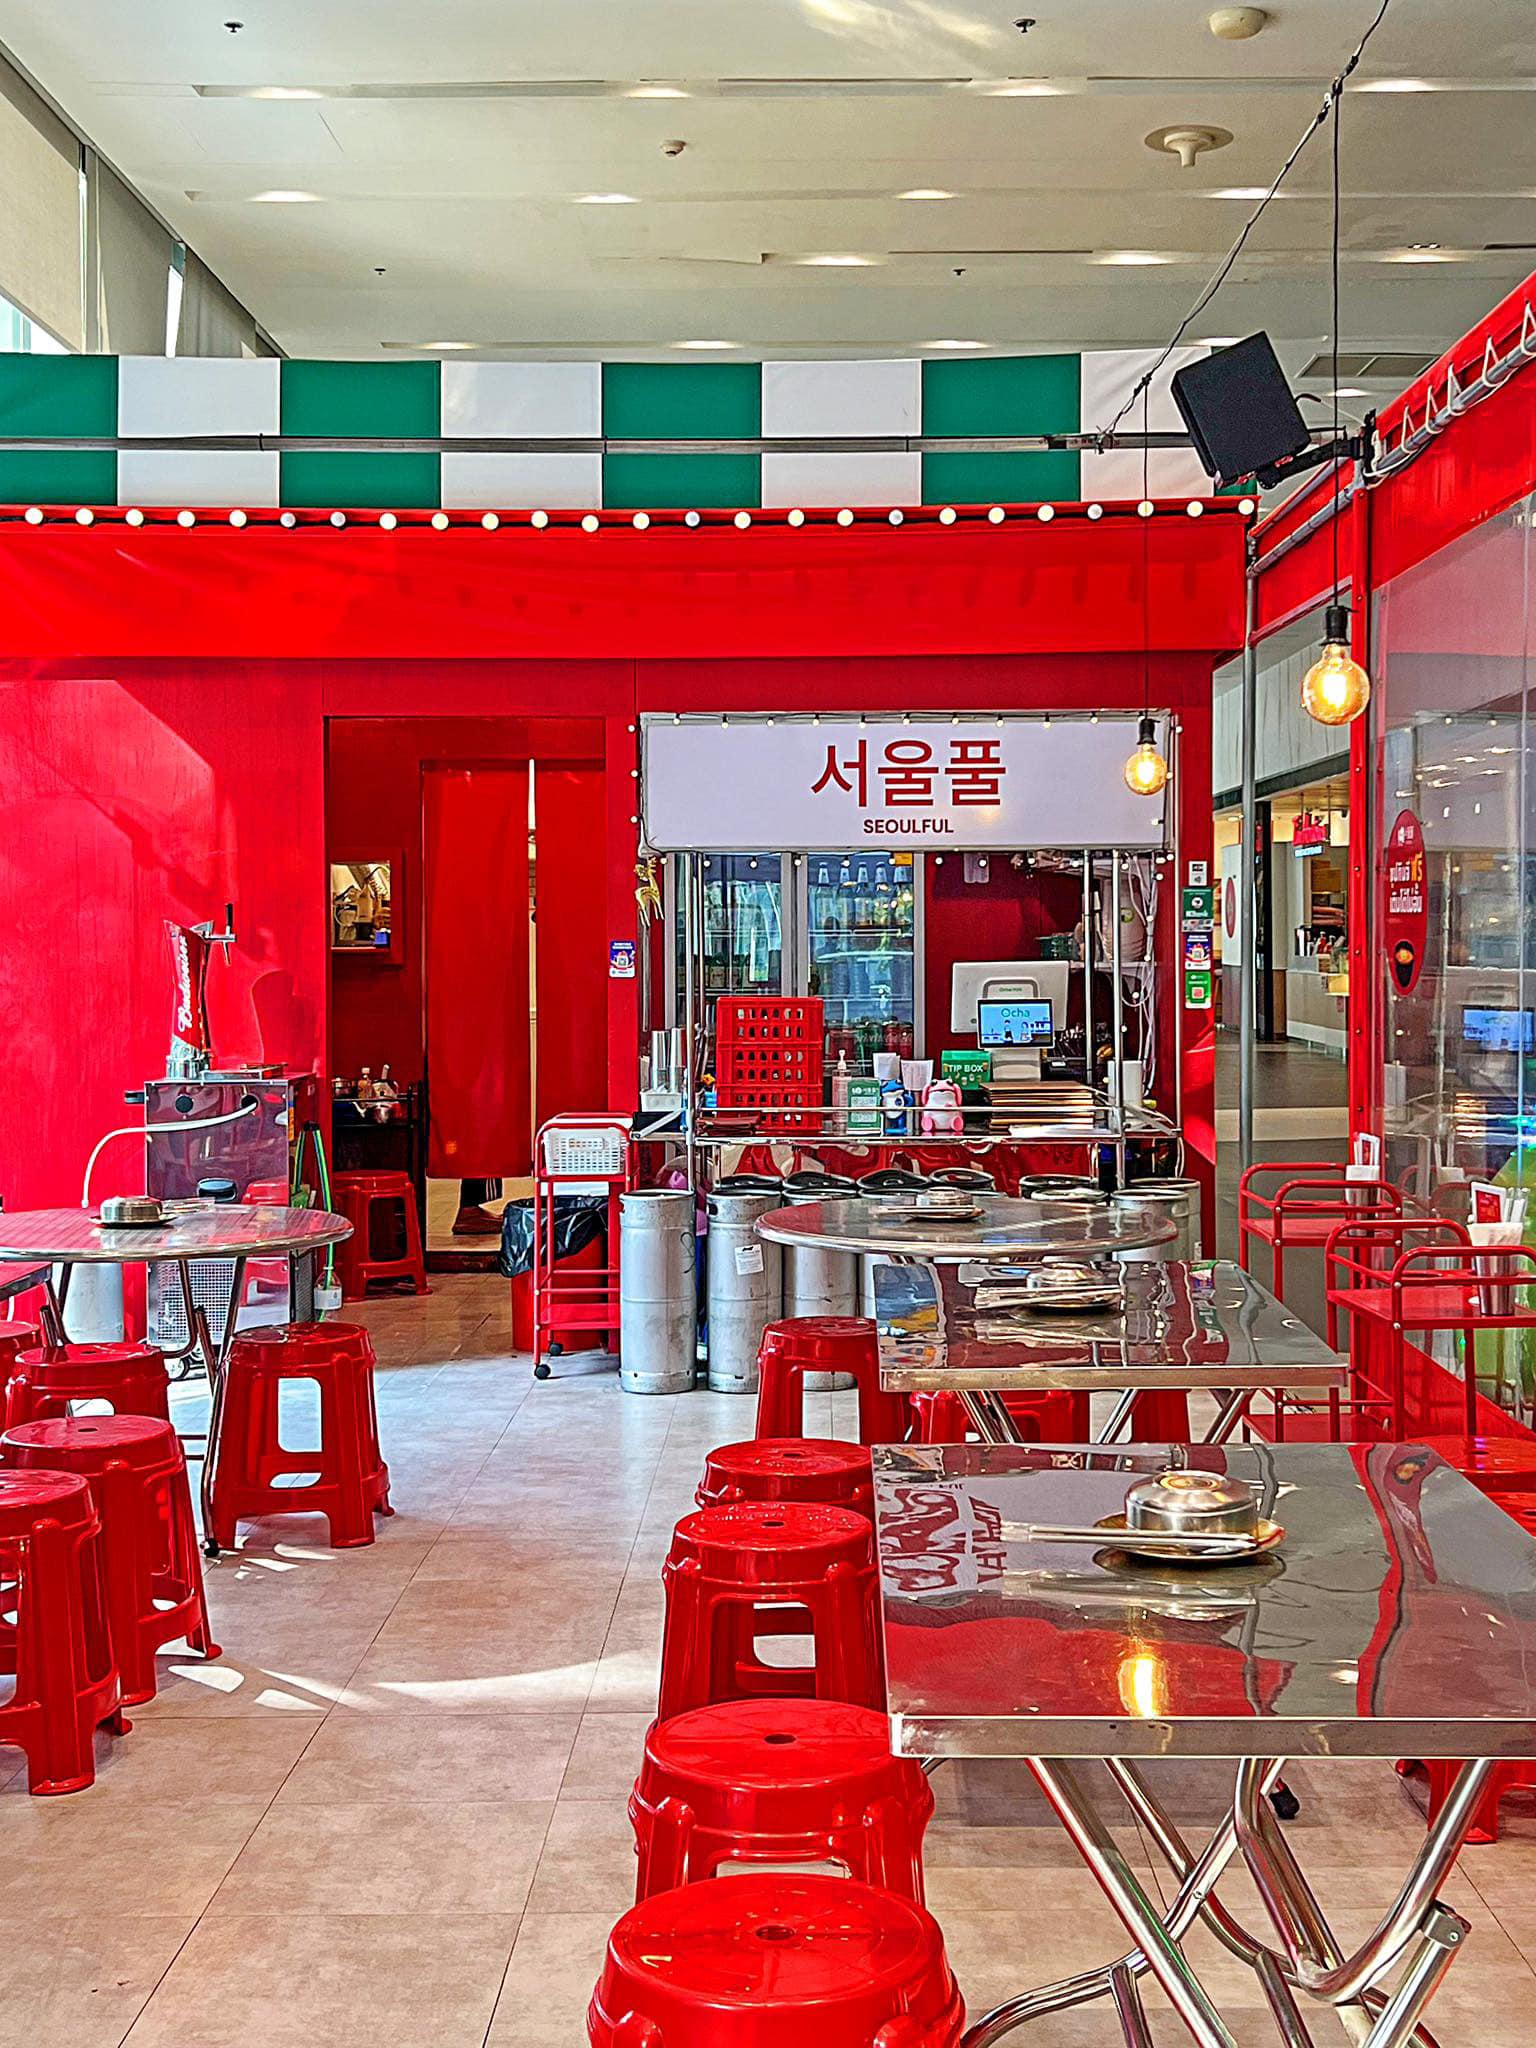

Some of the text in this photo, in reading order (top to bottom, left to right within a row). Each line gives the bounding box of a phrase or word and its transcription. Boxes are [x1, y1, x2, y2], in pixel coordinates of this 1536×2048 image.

[810, 739, 1007, 807] 서울풀
[863, 818, 954, 834] SEOULFUL
[177, 935, 193, 1033] Budweiser
[1000, 1008, 1031, 1018] Ocha
[949, 1064, 984, 1072] TIP BOX
